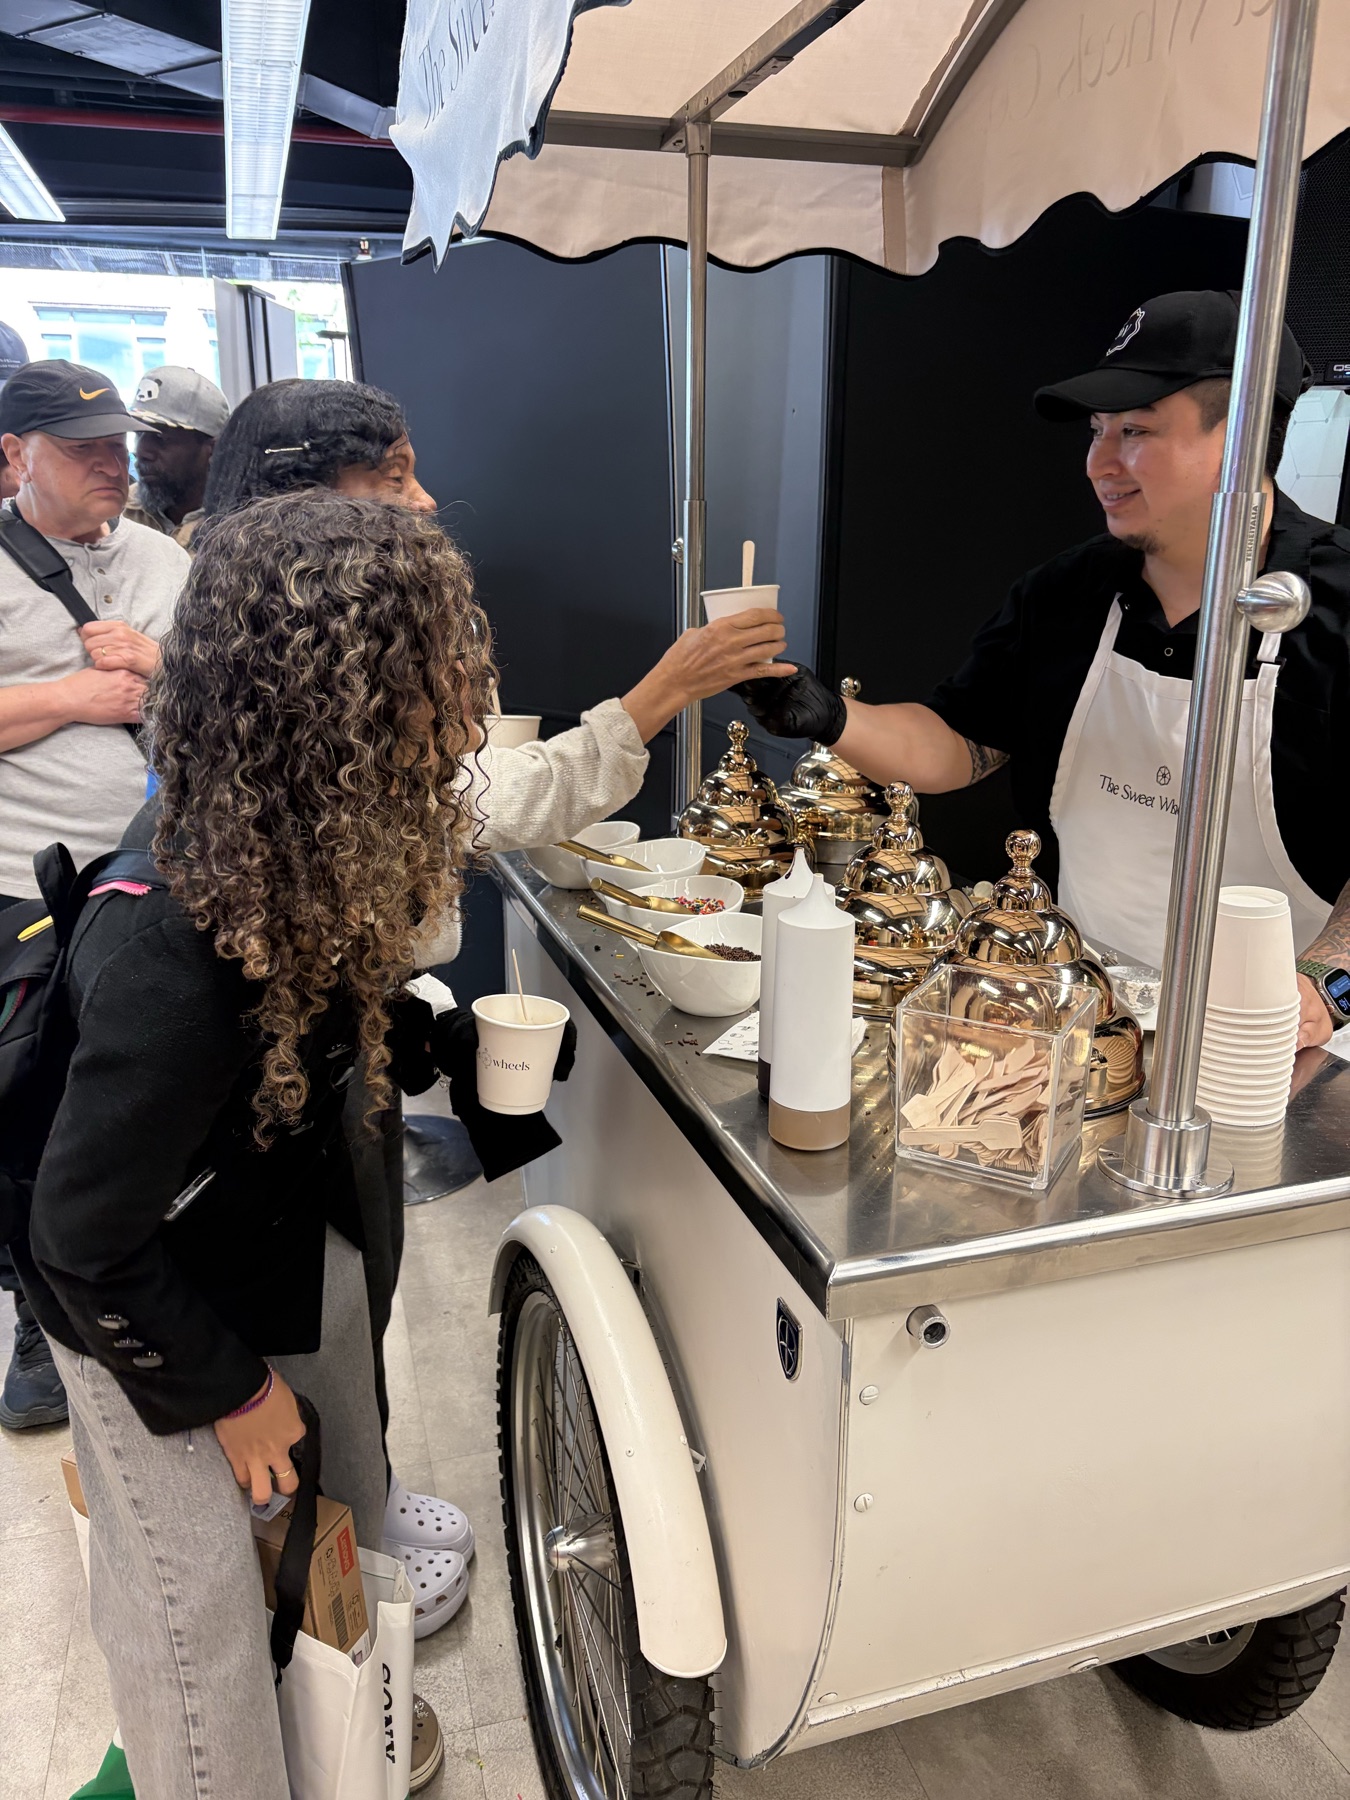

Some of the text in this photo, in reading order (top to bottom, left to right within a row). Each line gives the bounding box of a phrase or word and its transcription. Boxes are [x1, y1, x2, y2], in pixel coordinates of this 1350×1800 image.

[418, 38, 445, 130] The
[1099, 774, 1120, 795] The
[1120, 784, 1155, 808] Sweet
[492, 1059, 530, 1071] wheels
[340, 1531, 350, 1570] Lenovo
